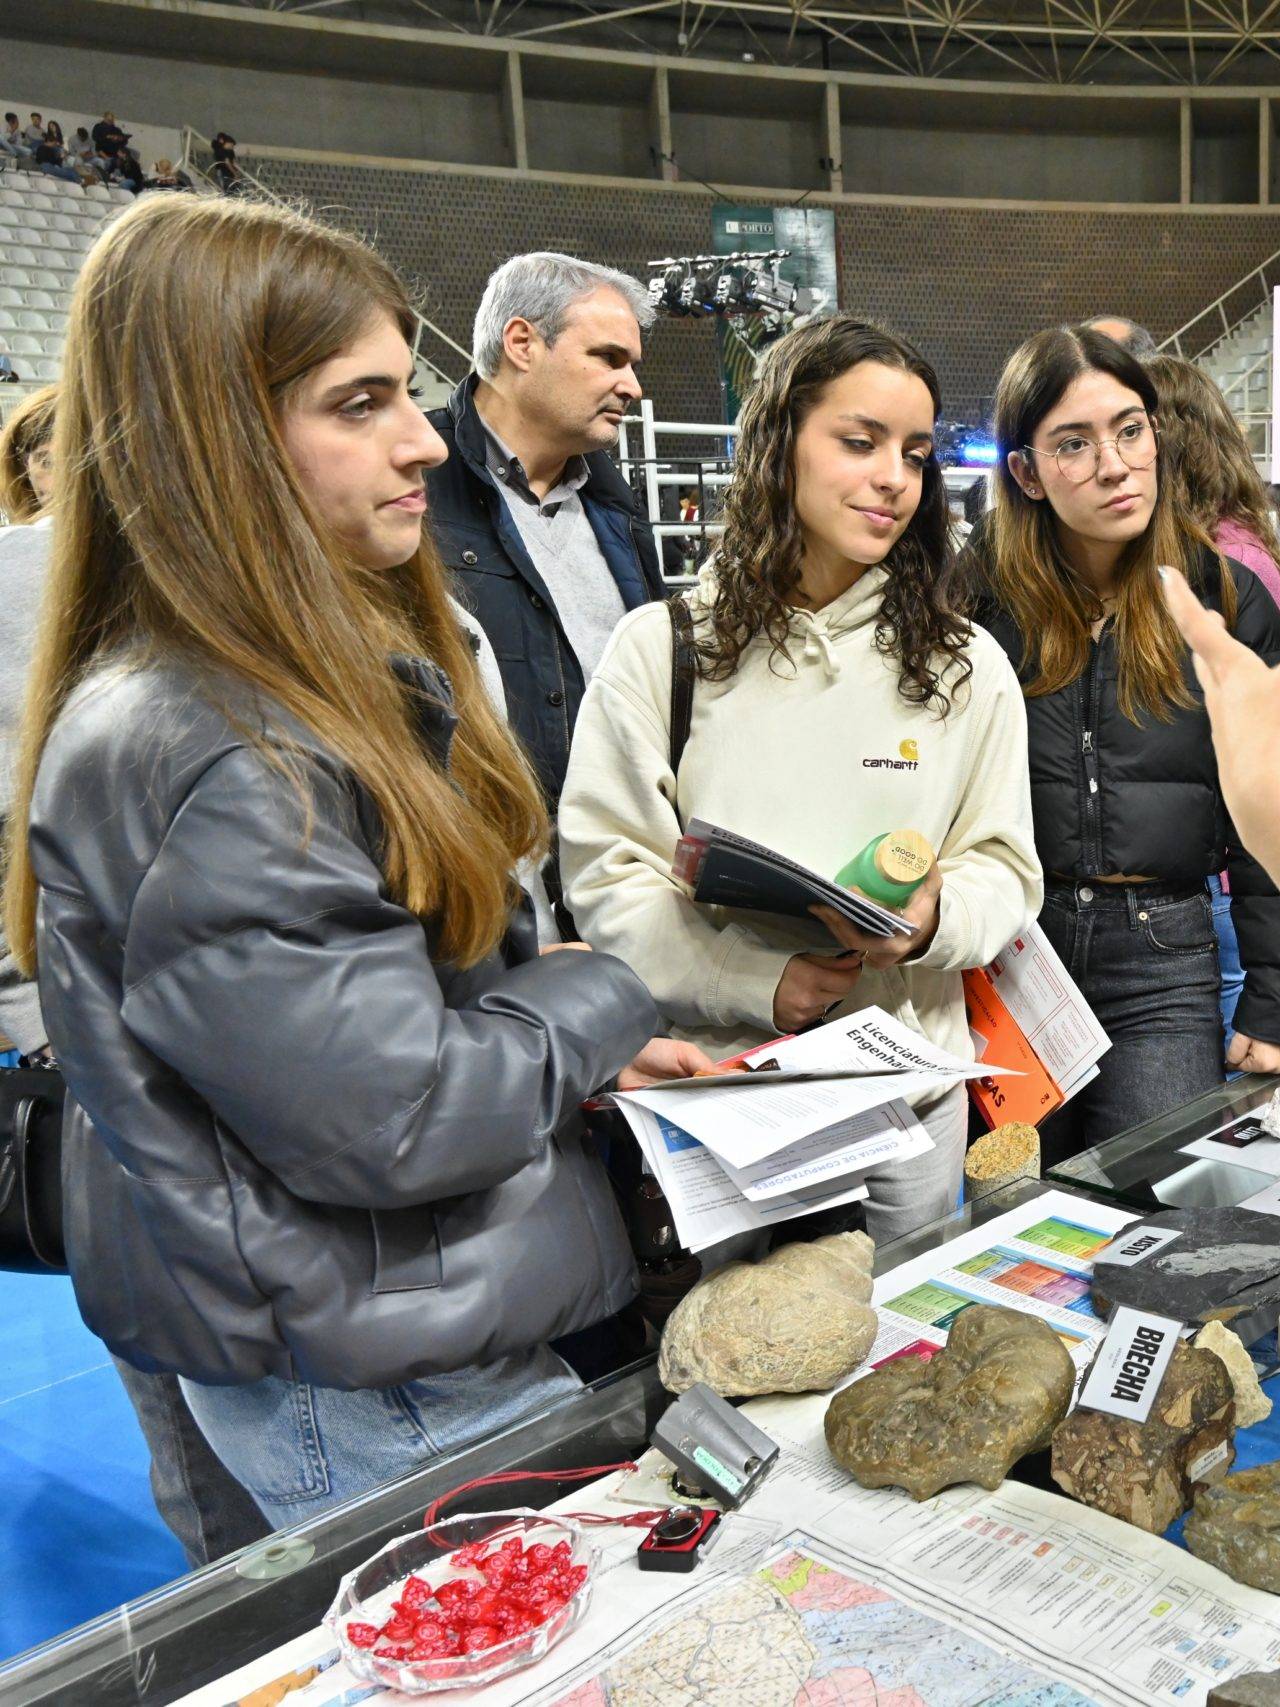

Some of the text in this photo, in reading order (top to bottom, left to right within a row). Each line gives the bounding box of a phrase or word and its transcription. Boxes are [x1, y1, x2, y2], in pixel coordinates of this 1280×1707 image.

[862, 758, 919, 771] carhartt
[846, 1029, 913, 1070] Engenhar
[861, 1022, 938, 1069] Licenciatura
[1120, 1235, 1162, 1257] XISTO
[1111, 1325, 1165, 1403] BRECHA
